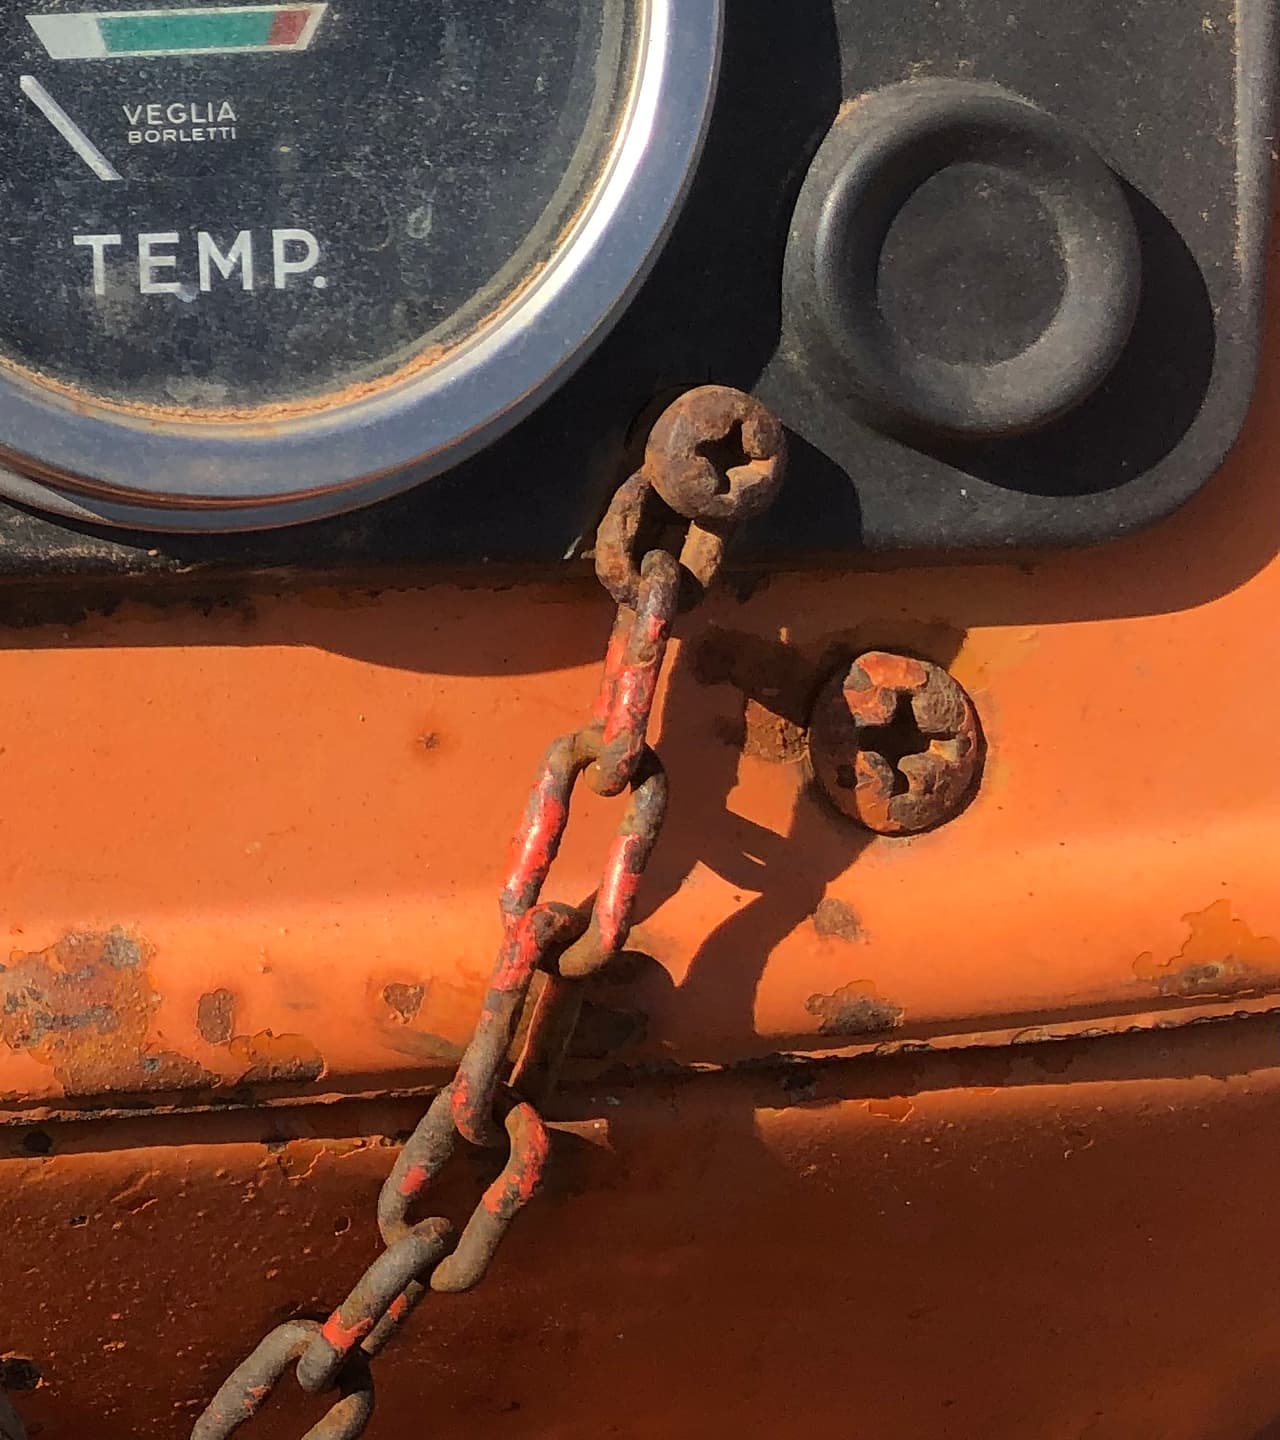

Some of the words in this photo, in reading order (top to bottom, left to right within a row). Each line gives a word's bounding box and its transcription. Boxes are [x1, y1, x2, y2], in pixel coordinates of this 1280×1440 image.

[122, 101, 238, 127] VEGLIA
[127, 125, 238, 145] BORLETTI
[73, 228, 328, 295] TEMP.
